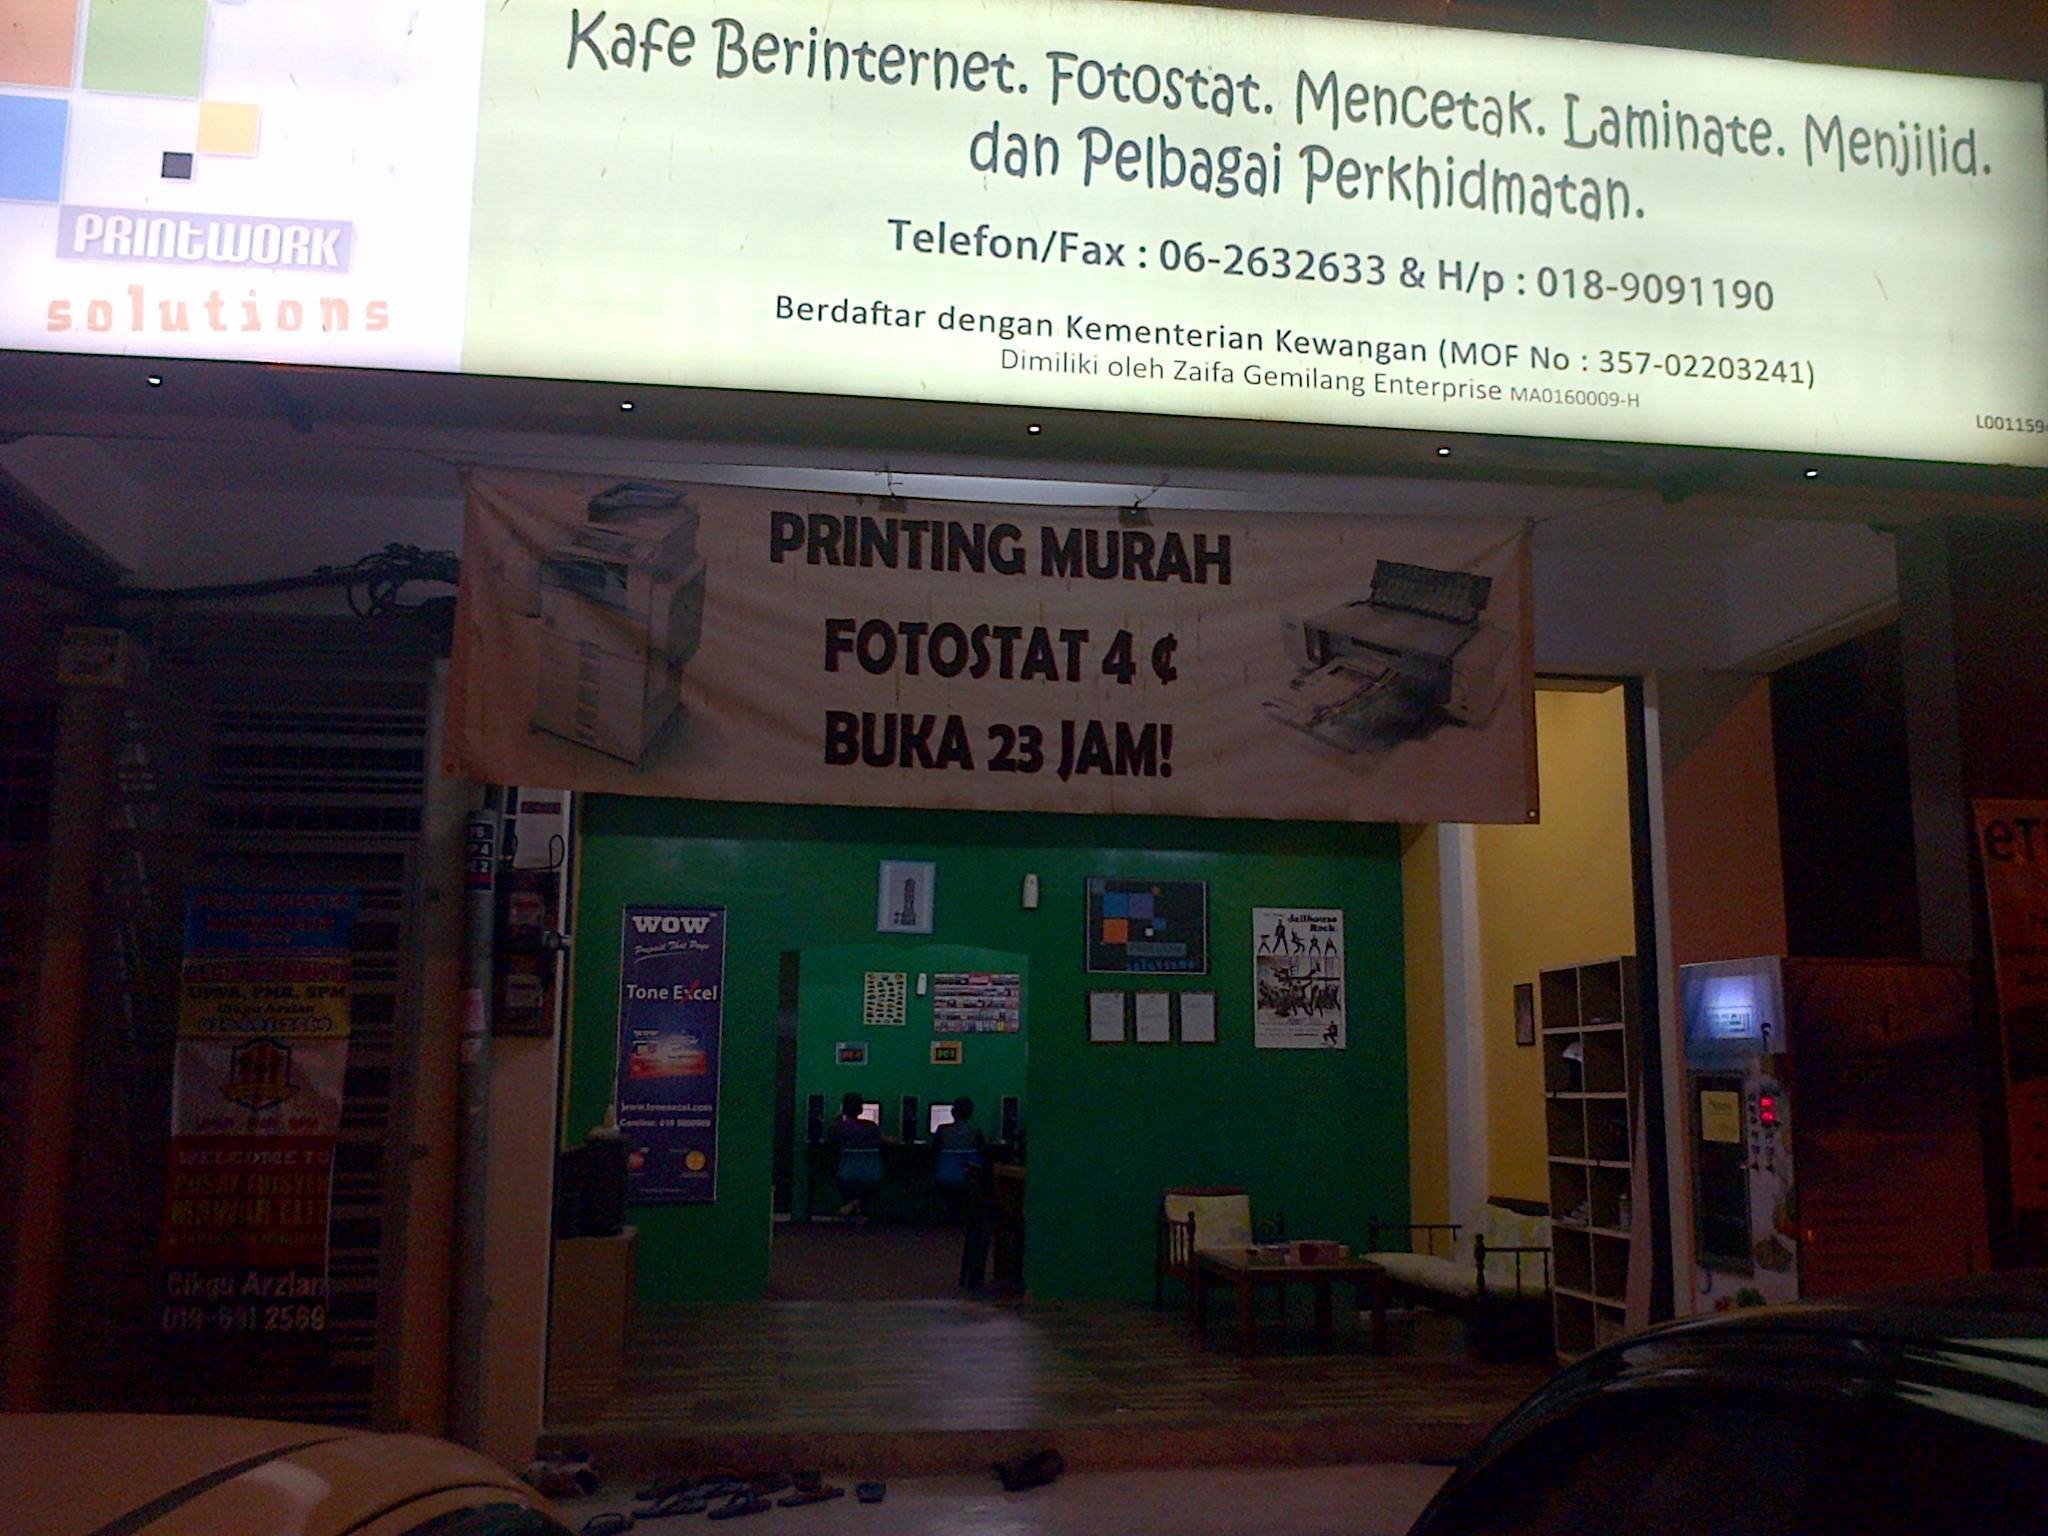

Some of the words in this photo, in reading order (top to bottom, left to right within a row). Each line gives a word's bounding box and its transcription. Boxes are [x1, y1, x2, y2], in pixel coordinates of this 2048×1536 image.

[567, 8, 696, 74] Kafe
[711, 18, 1028, 96] Berinternet.
[1046, 51, 1273, 117] Fotostat.
[1296, 69, 1546, 137] Mencetak.
[1563, 93, 1786, 159] Laminate.
[1806, 114, 1991, 177] Menjilid.
[970, 120, 1059, 179] dan
[1077, 126, 1282, 199] Pelbagai
[1299, 145, 1645, 222] Perkhidmatan.
[887, 219, 1126, 269] Telefon/Fax
[1160, 240, 1386, 286] 06-2632633
[1400, 257, 1426, 288] &
[1439, 260, 1505, 303] H/p
[1538, 267, 1774, 312] 018-9091190
[46, 284, 390, 332] solutions
[777, 295, 927, 330] Berdaftar
[938, 305, 1053, 343] dengan
[1067, 315, 1263, 352] Kementerian
[1277, 329, 1427, 367] Kewangan
[1439, 339, 1519, 369] (MOF
[1531, 346, 1570, 371] No
[1600, 350, 1815, 390] 357-02203241)
[1002, 349, 1098, 375] Dimiliki
[1109, 355, 1164, 380] oleh
[1174, 360, 1234, 384] Zaifa
[1244, 365, 1366, 397] Gemilang
[1375, 373, 1503, 402] Enterprise
[1511, 386, 1641, 408] MA0160009-H
[1976, 414, 2048, 433] L001159
[770, 511, 1026, 576] PRINTING
[1041, 525, 1232, 586] MURAH
[825, 618, 1089, 683] FOTOSTAT
[1102, 629, 1137, 685] 4
[825, 711, 974, 771] BUKA
[987, 724, 1044, 774] 23
[1057, 719, 1173, 782] JAM!
[632, 916, 710, 934] WOW
[626, 984, 669, 999] Tone
[673, 977, 718, 1005] Excel
